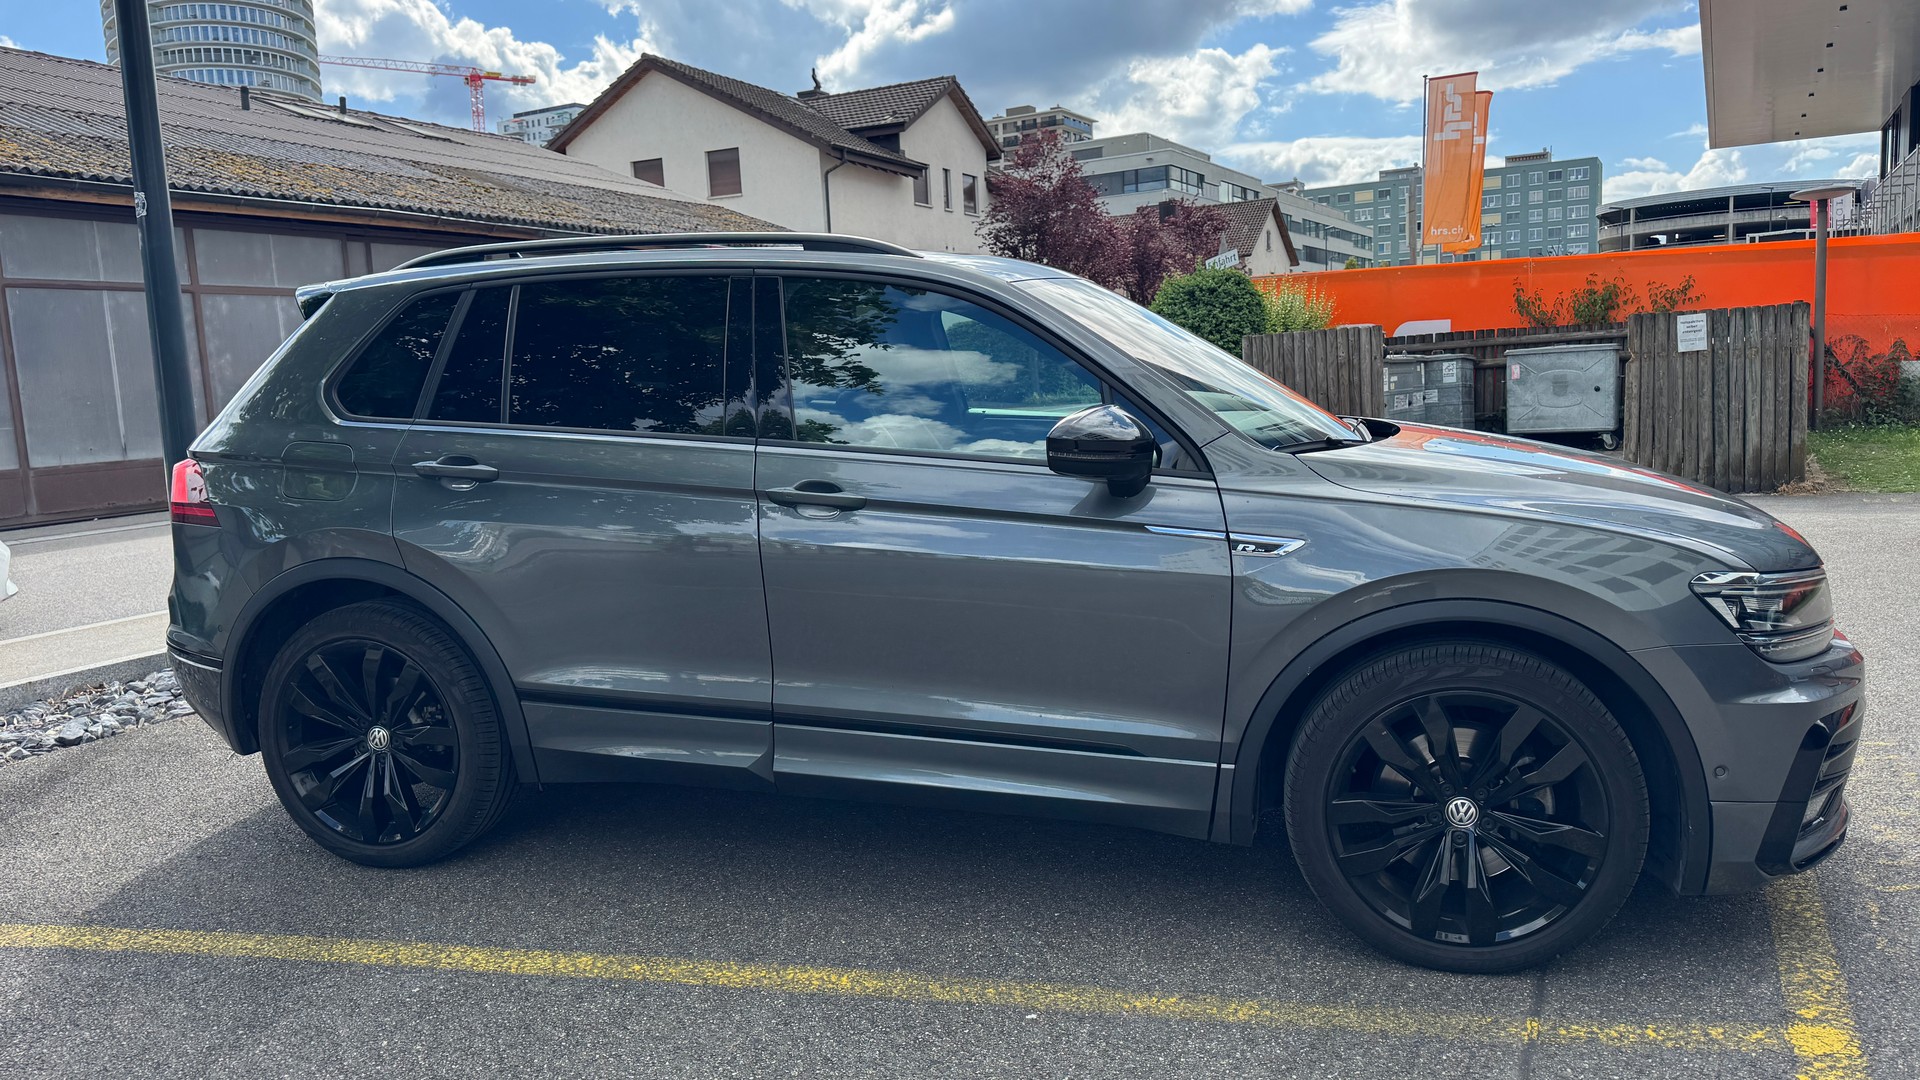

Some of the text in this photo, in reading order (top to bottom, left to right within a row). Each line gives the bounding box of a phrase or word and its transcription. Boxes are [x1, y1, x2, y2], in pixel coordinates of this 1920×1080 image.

[1431, 225, 1464, 236] hrs.ch
[1207, 253, 1237, 268] Enfahrt
[1236, 543, 1256, 553] R
[1447, 798, 1477, 826] VW
